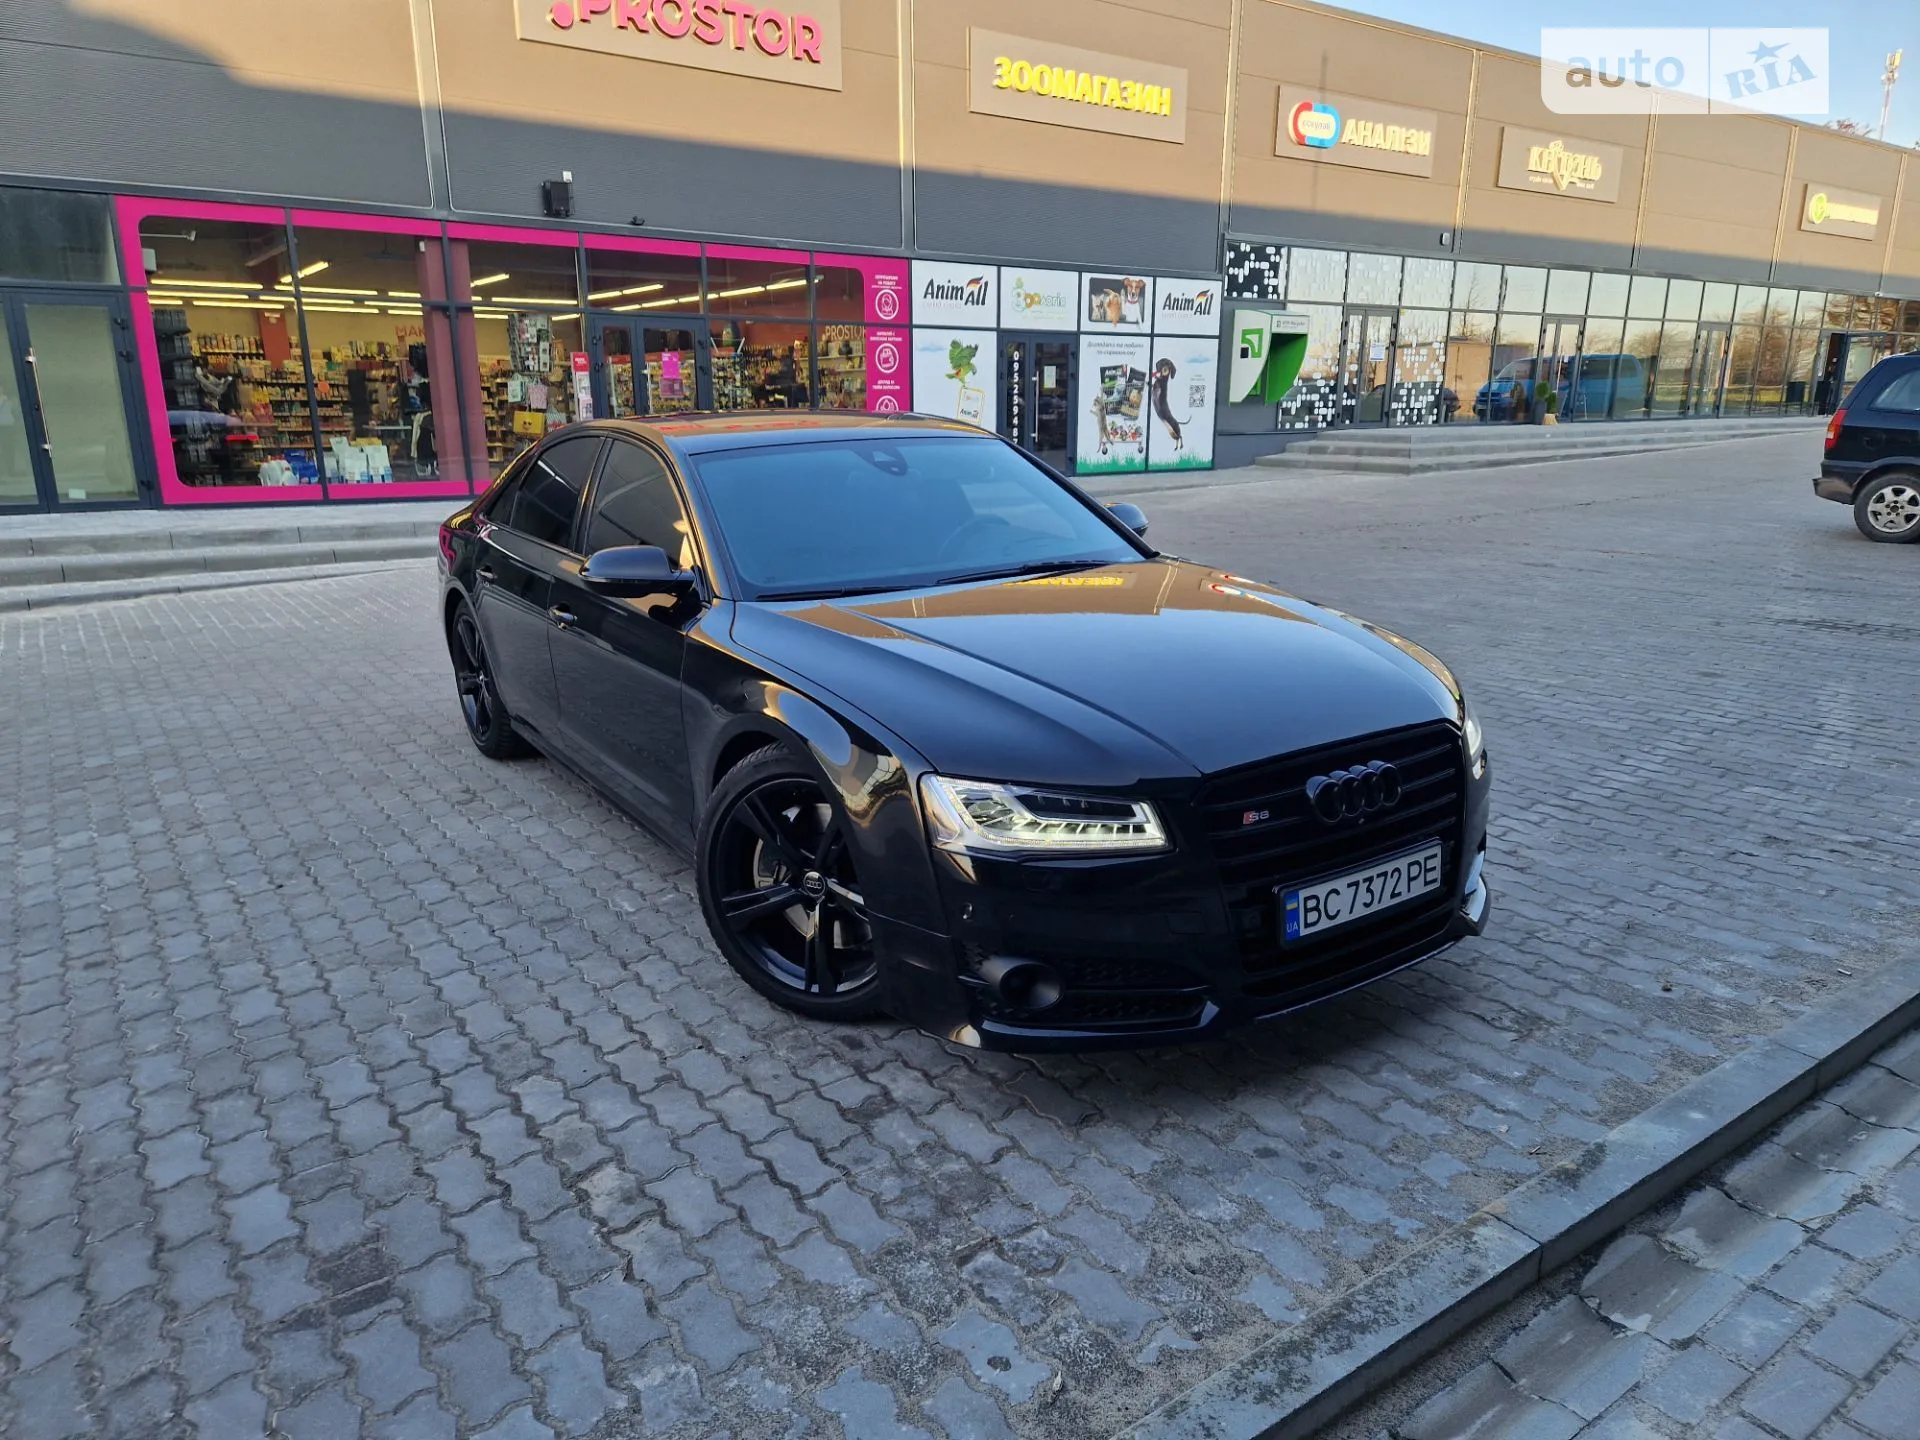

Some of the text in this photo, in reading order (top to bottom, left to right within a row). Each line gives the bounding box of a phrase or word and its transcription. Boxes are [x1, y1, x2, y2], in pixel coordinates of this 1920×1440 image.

[993, 56, 1171, 117] ЗООМАГАЗИН
[1341, 118, 1432, 156] АНАЛІЗИ
[1286, 920, 1299, 933] UA
